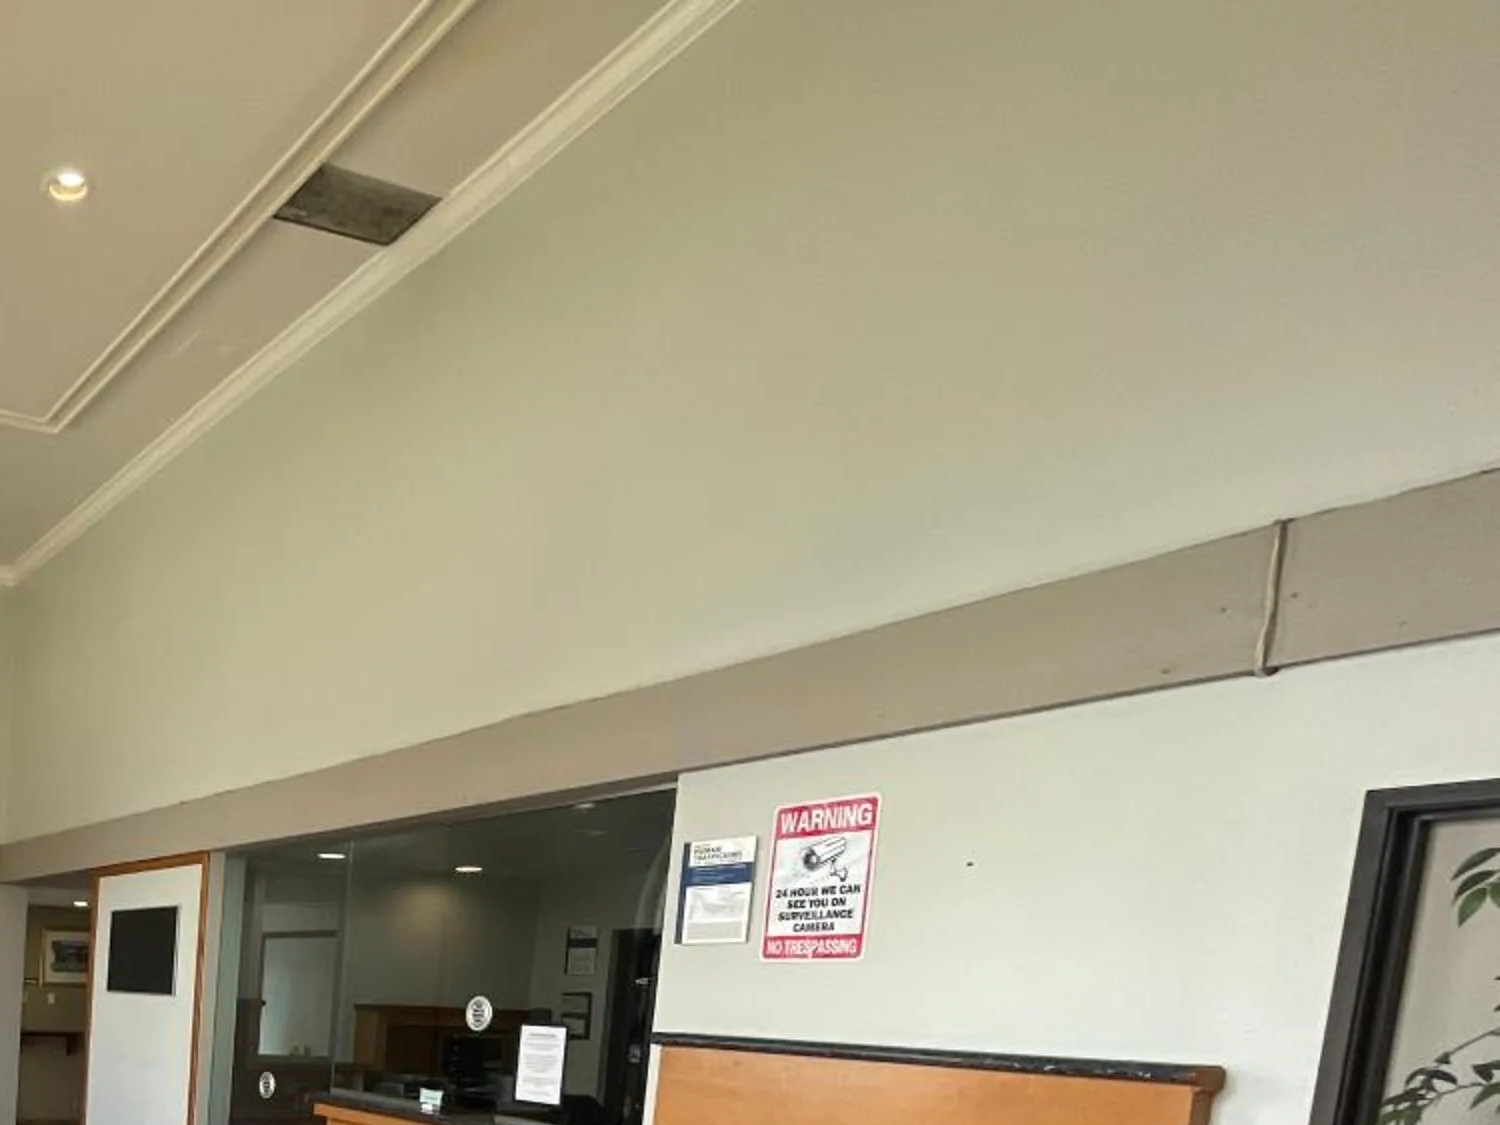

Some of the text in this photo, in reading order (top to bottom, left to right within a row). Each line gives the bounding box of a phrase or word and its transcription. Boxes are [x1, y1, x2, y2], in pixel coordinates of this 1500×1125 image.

[780, 804, 873, 834] WARNING
[775, 884, 861, 899] 24 HOUR WE CAN
[787, 897, 847, 909] SEE YOU ON
[778, 909, 854, 921] SURVEILLANCE
[792, 920, 836, 932] CAMERA
[766, 939, 857, 955] NO TRESPASSING
